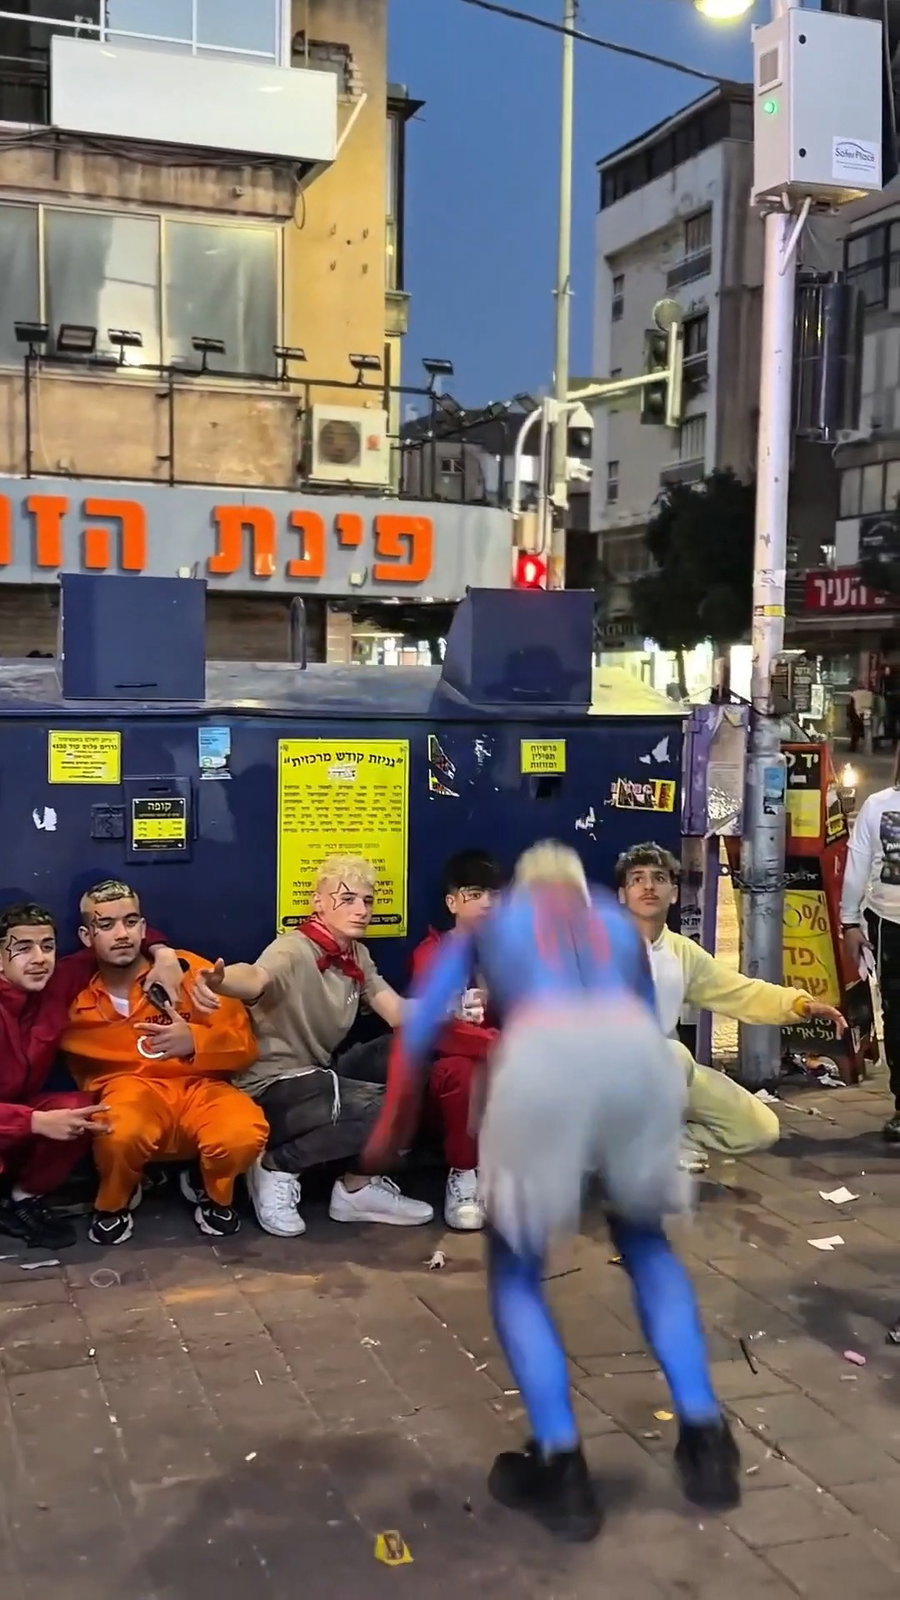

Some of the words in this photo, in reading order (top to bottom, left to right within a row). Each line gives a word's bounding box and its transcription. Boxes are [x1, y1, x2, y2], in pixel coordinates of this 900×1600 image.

[0, 493, 147, 571] הז
[208, 504, 434, 582] פינת
[335, 751, 365, 764] קודש
[147, 802, 172, 812] קופה
[796, 1027, 816, 1040] אף
[816, 1027, 834, 1042] על
